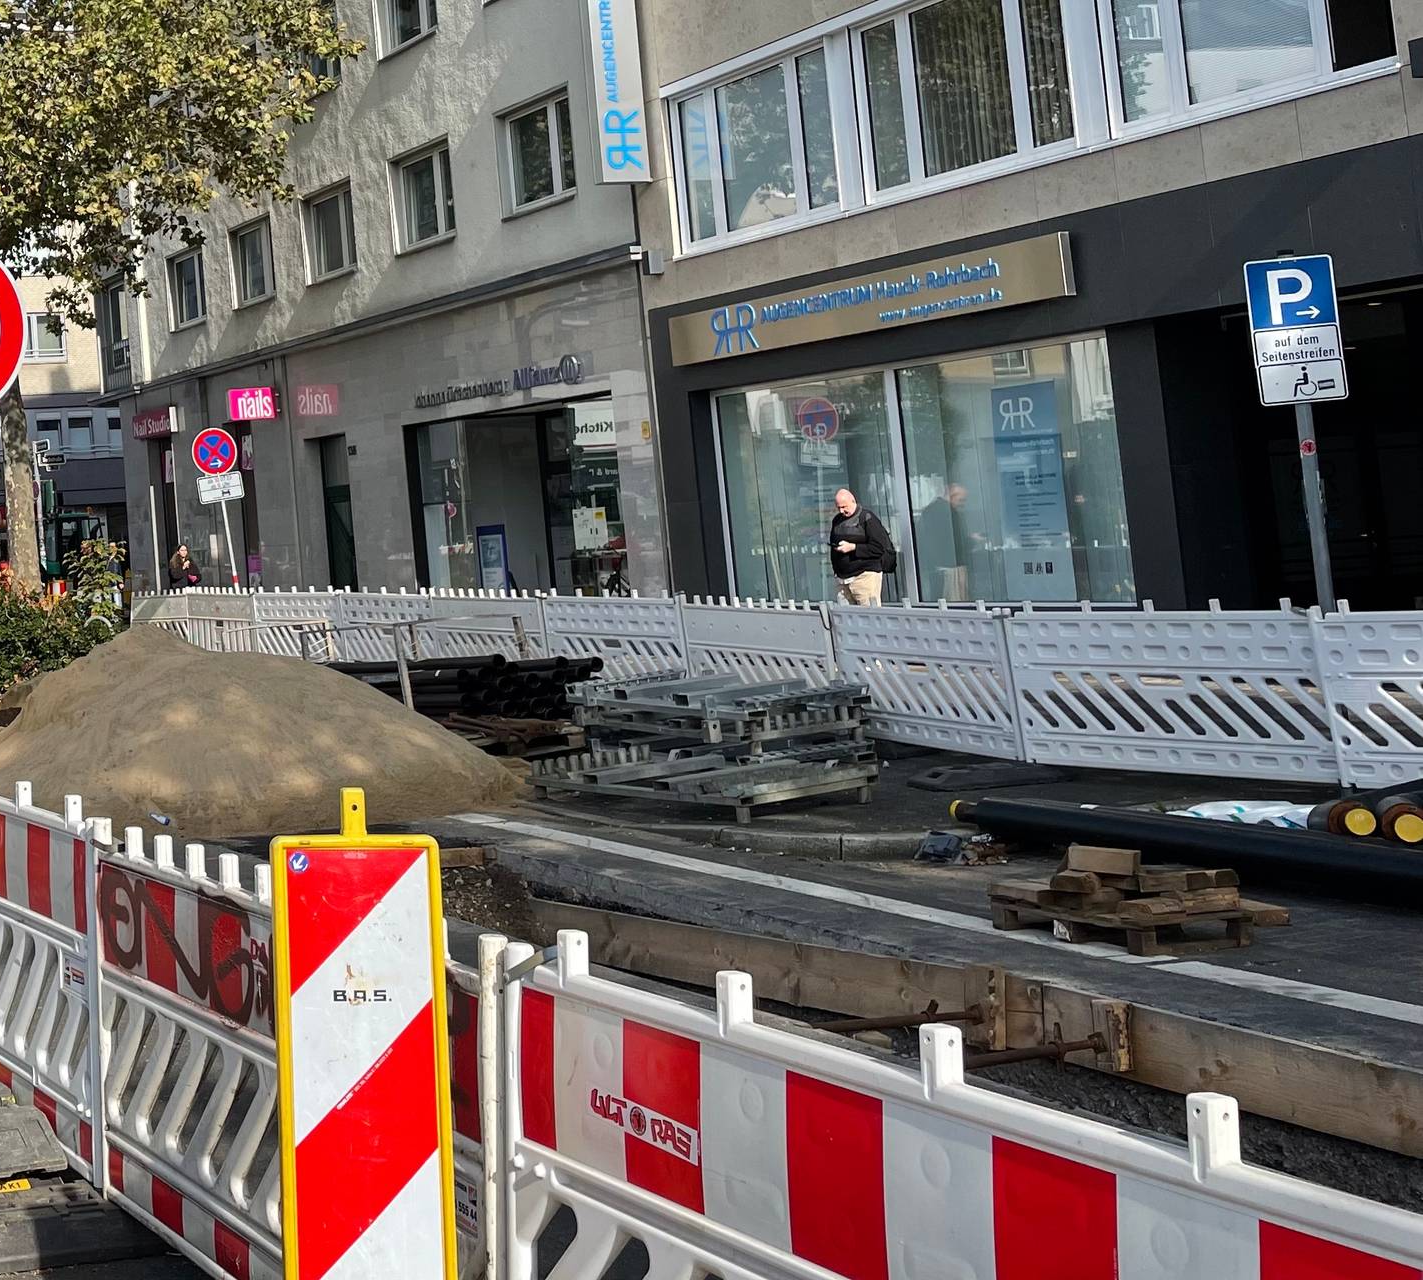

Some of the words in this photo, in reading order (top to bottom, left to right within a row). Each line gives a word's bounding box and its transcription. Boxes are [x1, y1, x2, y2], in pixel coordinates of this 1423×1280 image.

[761, 283, 873, 324] AUGENCENTRUM
[1266, 268, 1313, 326] P
[1274, 337, 1291, 348] auf
[1297, 334, 1319, 346] dem
[1261, 347, 1336, 363] Seitenstreifen
[237, 390, 273, 419] nails
[133, 420, 147, 438] Nail
[333, 989, 393, 1004] B.A.S.
